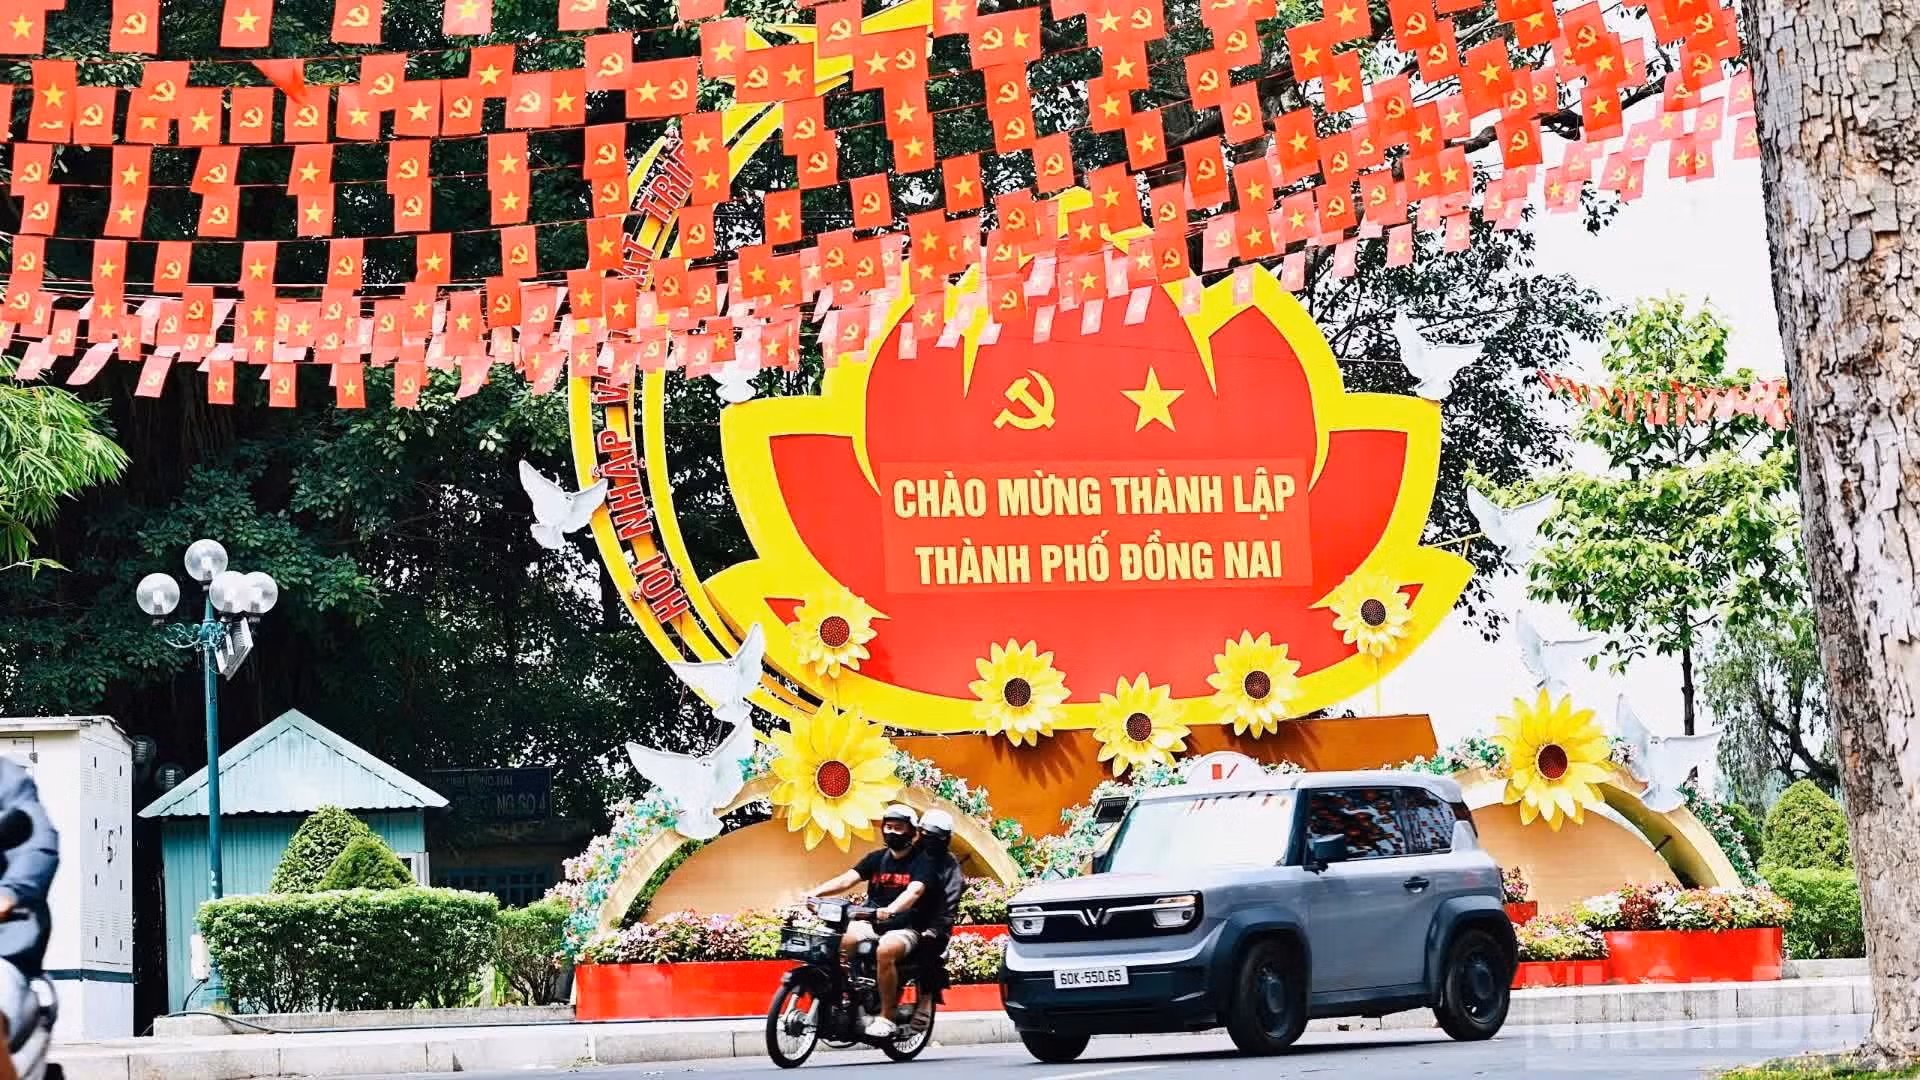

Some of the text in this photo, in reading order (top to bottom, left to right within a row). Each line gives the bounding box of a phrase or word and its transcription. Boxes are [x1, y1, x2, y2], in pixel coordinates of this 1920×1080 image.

[592, 429, 655, 541] NHẬP
[893, 466, 1296, 520] CHÀO MỪNG THÀNH LẬP
[914, 529, 1283, 585] THÀNH PHỐ ĐỒNG NAI
[631, 550, 690, 625] HỘI
[1060, 969, 1122, 985] 60K-550.65
